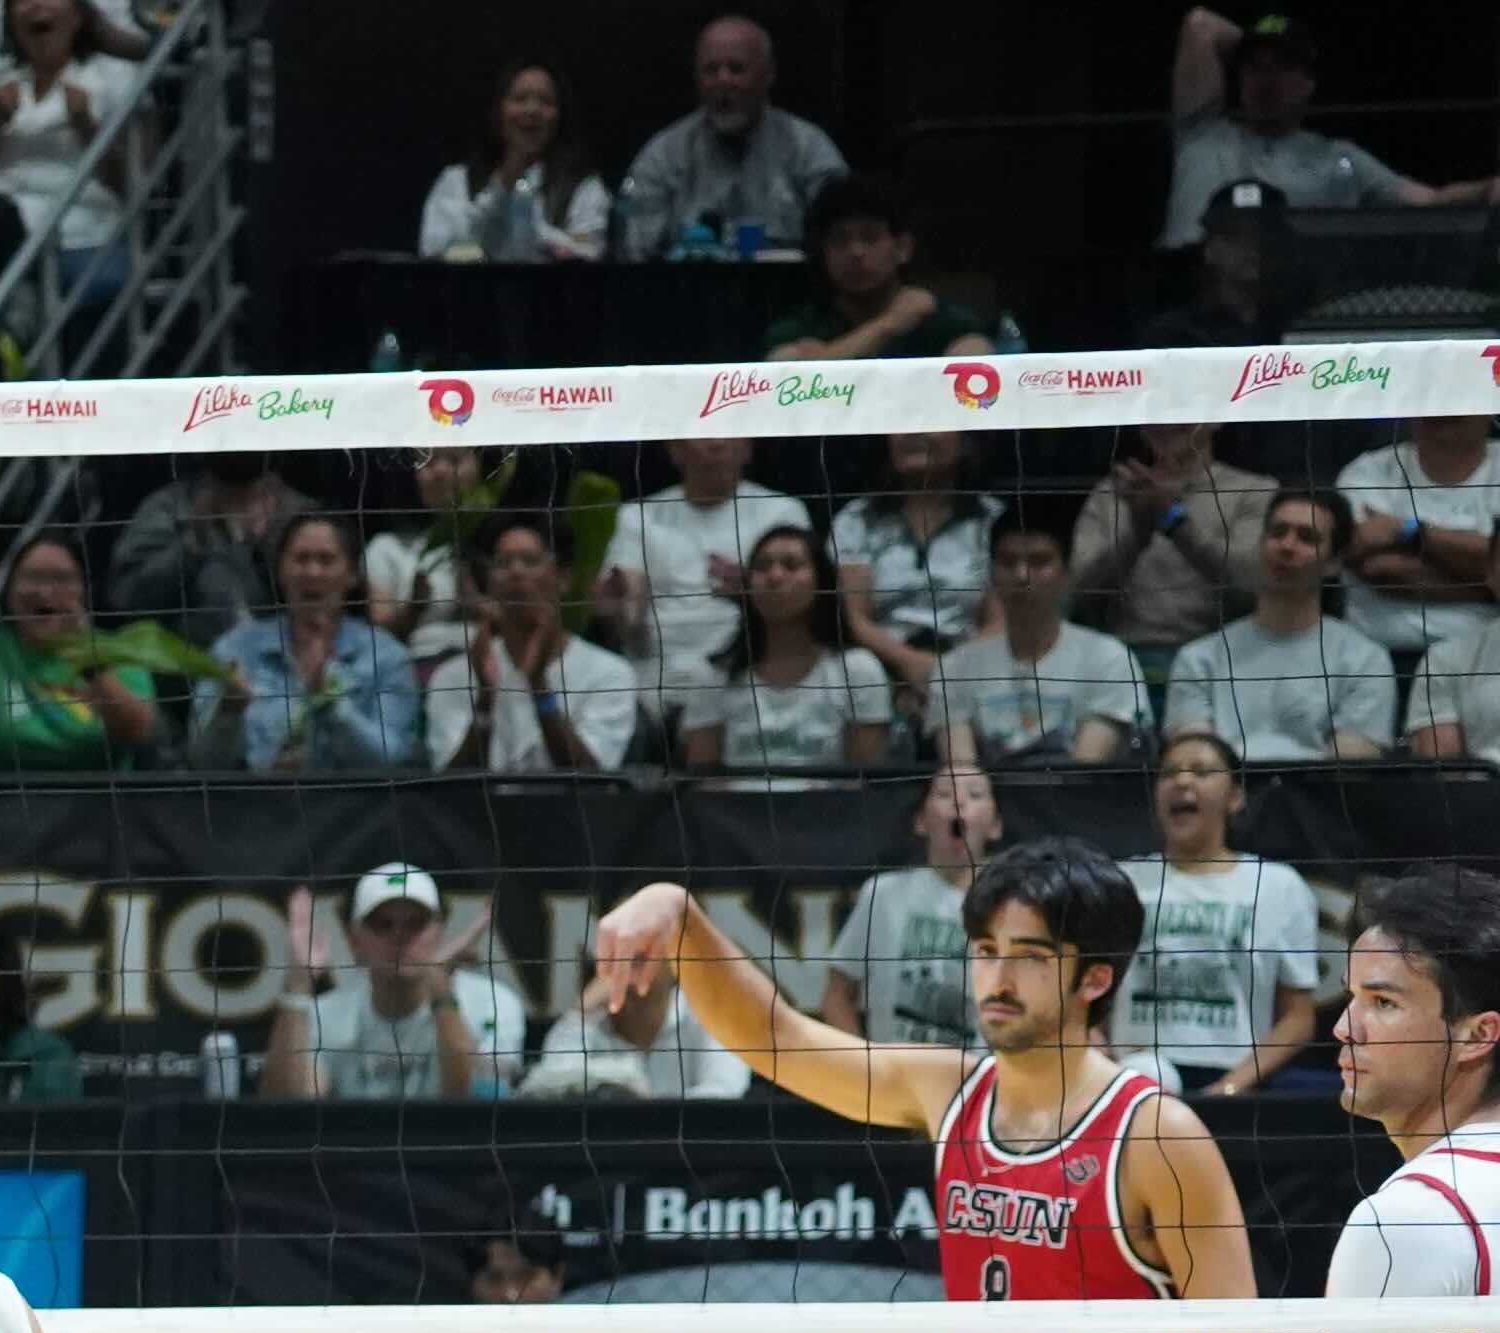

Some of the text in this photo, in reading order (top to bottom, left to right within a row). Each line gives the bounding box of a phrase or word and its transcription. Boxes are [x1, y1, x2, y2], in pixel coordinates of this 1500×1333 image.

[1067, 368, 1143, 389] HAWAII
[1310, 356, 1390, 390] Bakery
[257, 389, 334, 421] Bakery
[539, 384, 613, 406] HAWAII
[777, 373, 856, 407] Bakery
[26, 399, 98, 418] HAWAII
[644, 1182, 876, 1241] Bankoh
[944, 1180, 1077, 1250] CSUN
